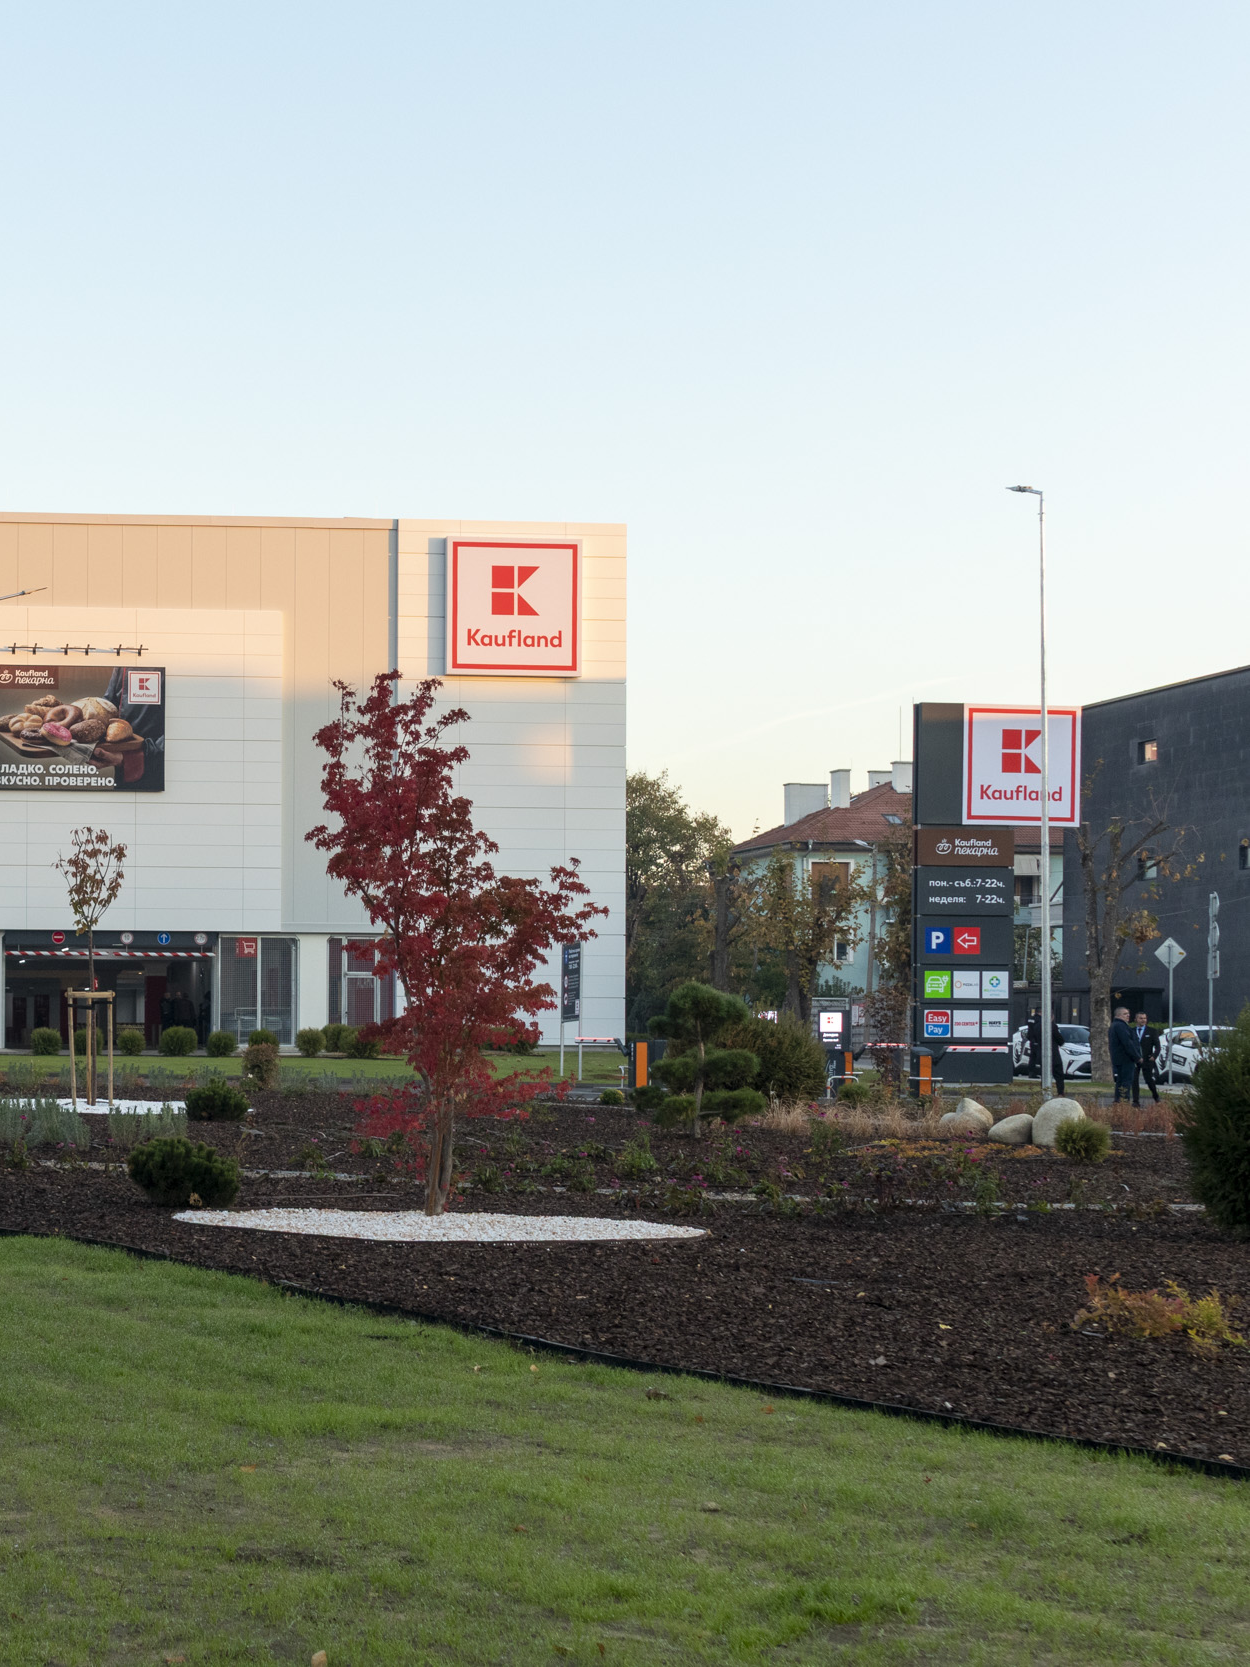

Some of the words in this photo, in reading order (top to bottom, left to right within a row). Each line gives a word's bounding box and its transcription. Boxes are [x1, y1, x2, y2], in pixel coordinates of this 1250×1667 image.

[467, 628, 562, 648] Kaufland
[15, 669, 48, 677] Kaufland
[14, 677, 55, 686] пекарна
[49, 764, 99, 775] СОЛЕНО.
[44, 776, 117, 787] ПРОВЕРЕНО.
[954, 838, 992, 847] Kaufland
[954, 846, 999, 857] пекарна
[928, 895, 967, 905] неделя:
[975, 895, 1005, 904] 7-22ч.
[931, 931, 945, 949] P
[928, 1013, 947, 1024] Easy
[928, 1025, 943, 1035] Pay
